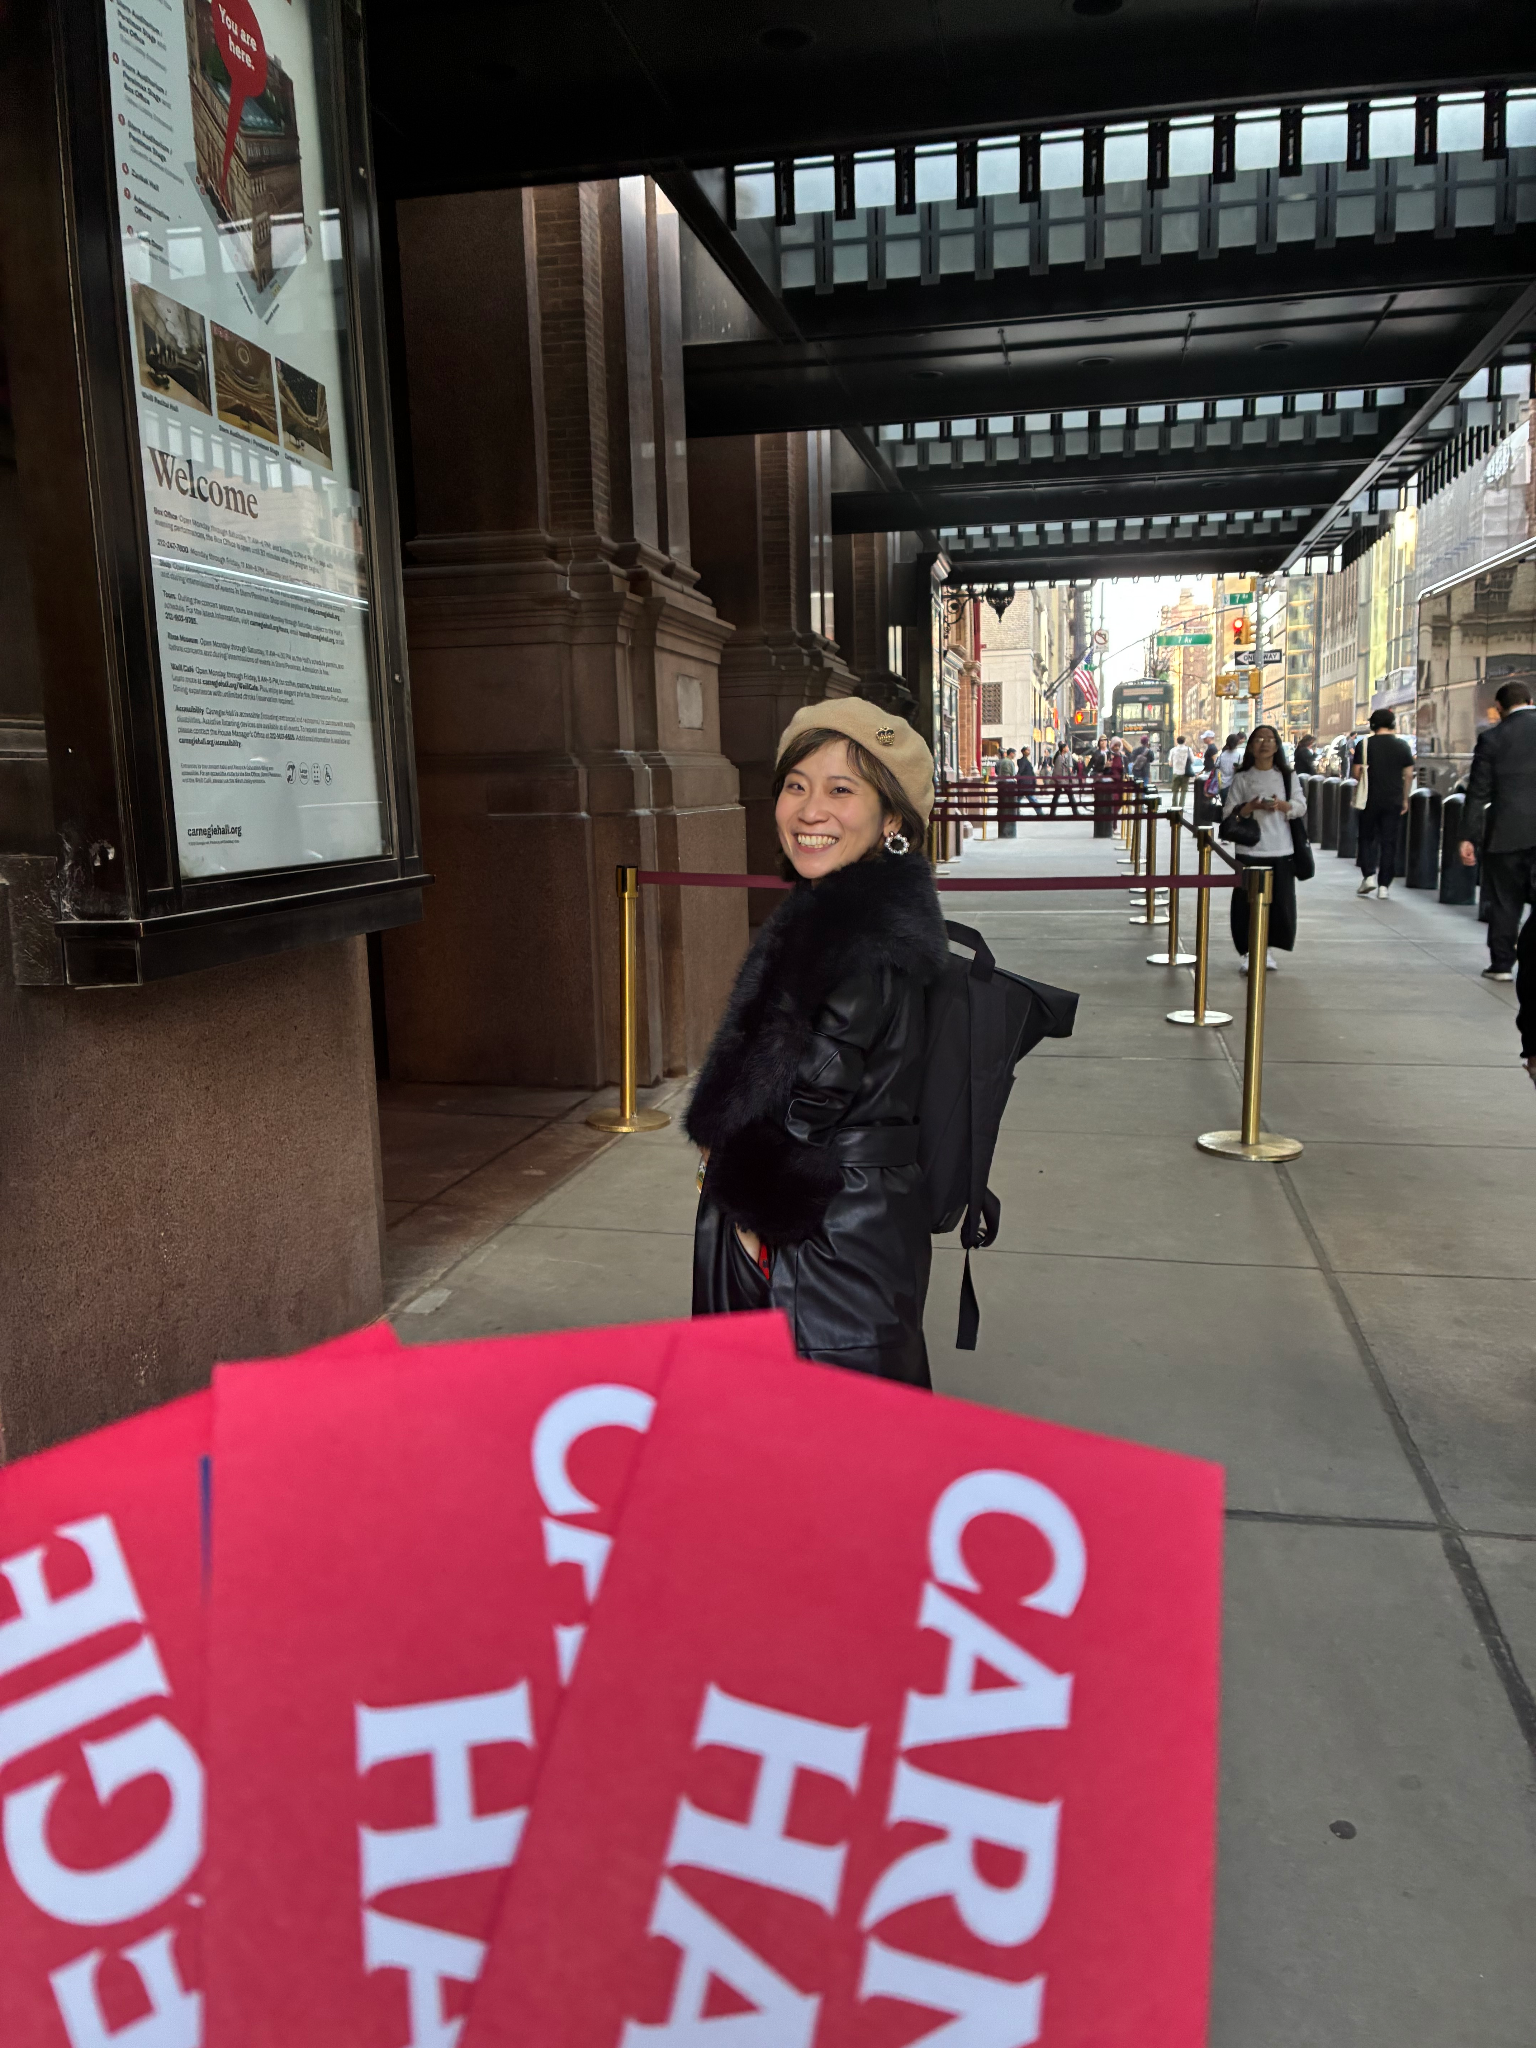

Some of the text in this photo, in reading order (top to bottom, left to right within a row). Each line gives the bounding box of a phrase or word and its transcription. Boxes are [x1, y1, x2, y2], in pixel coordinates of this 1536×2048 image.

[118, 19, 145, 48] Box Office
[143, 27, 157, 47] Stage
[218, 3, 257, 51] You are
[229, 33, 255, 71] here.
[124, 80, 150, 108] Box Office
[147, 86, 161, 105] Stage
[131, 167, 160, 194] Zankel Hall
[134, 204, 152, 224] Offices
[147, 446, 259, 519] Welcome
[1235, 594, 1240, 604] 7
[1184, 636, 1193, 644] Av
[187, 824, 242, 839] carnegiehall.org
